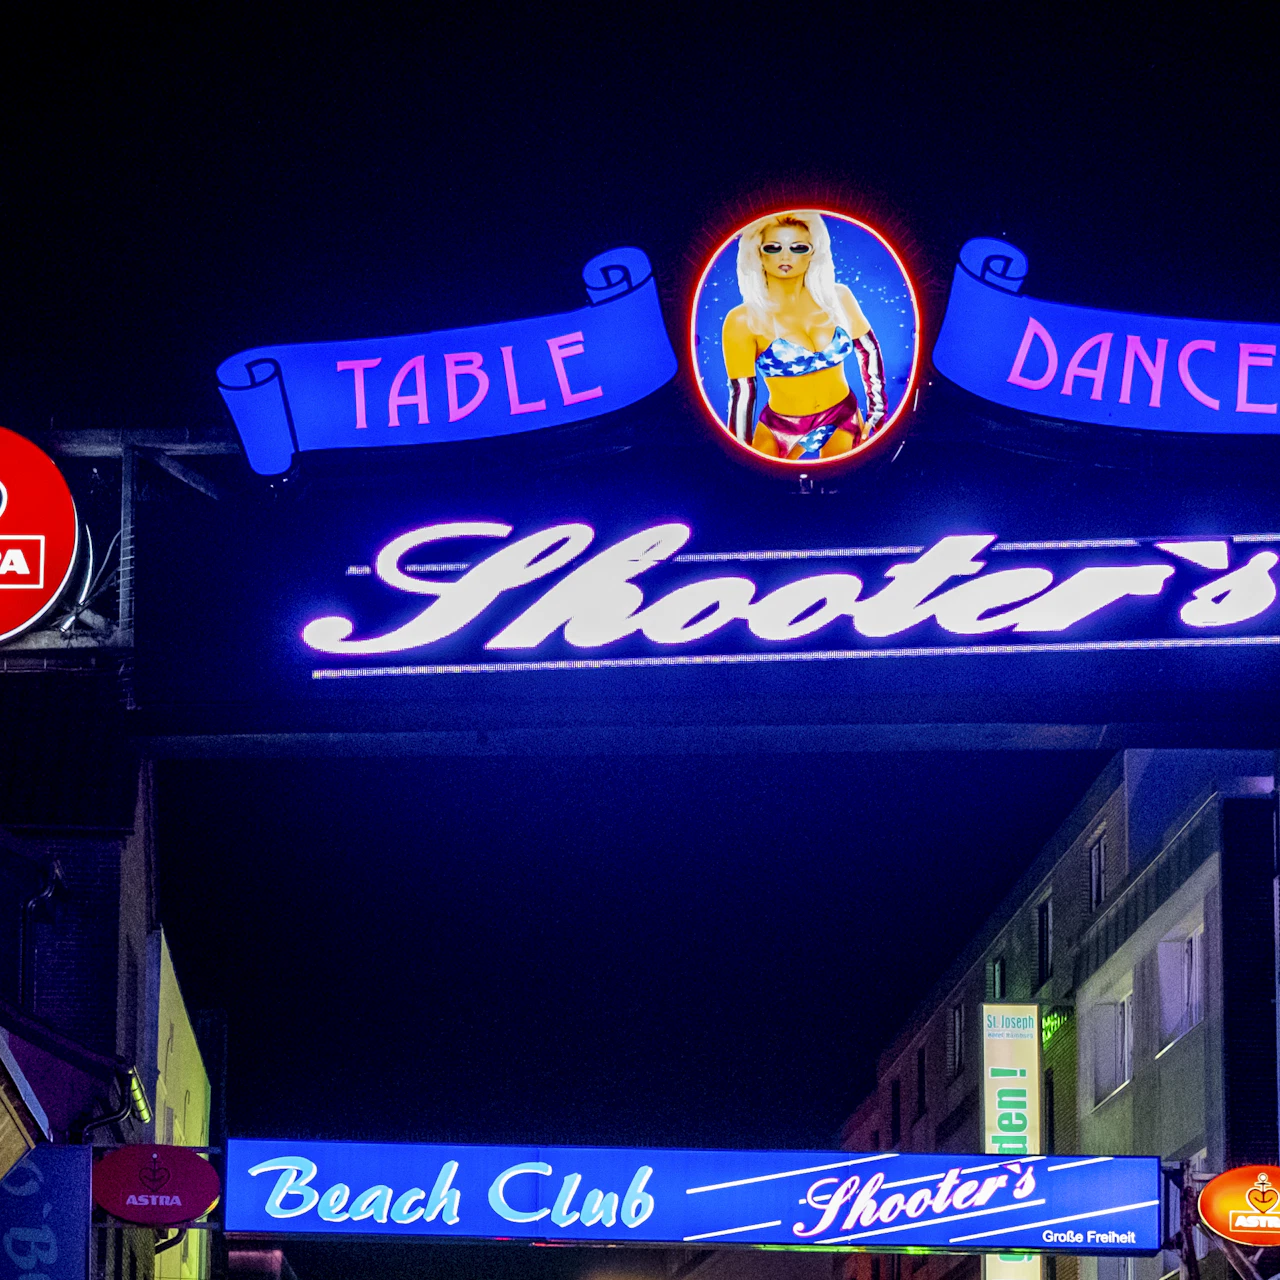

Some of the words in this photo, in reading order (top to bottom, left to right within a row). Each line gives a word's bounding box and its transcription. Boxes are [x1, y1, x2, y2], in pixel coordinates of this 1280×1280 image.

[337, 331, 603, 429] TABLE
[1007, 318, 1279, 415] DANCE
[1001, 1014, 1035, 1030] Joseph
[126, 1194, 182, 1207] ASTRA
[248, 1156, 461, 1225] Beach
[487, 1161, 655, 1229] Club
[1043, 1229, 1083, 1244] Große
[1086, 1229, 1137, 1244] Freiheit
